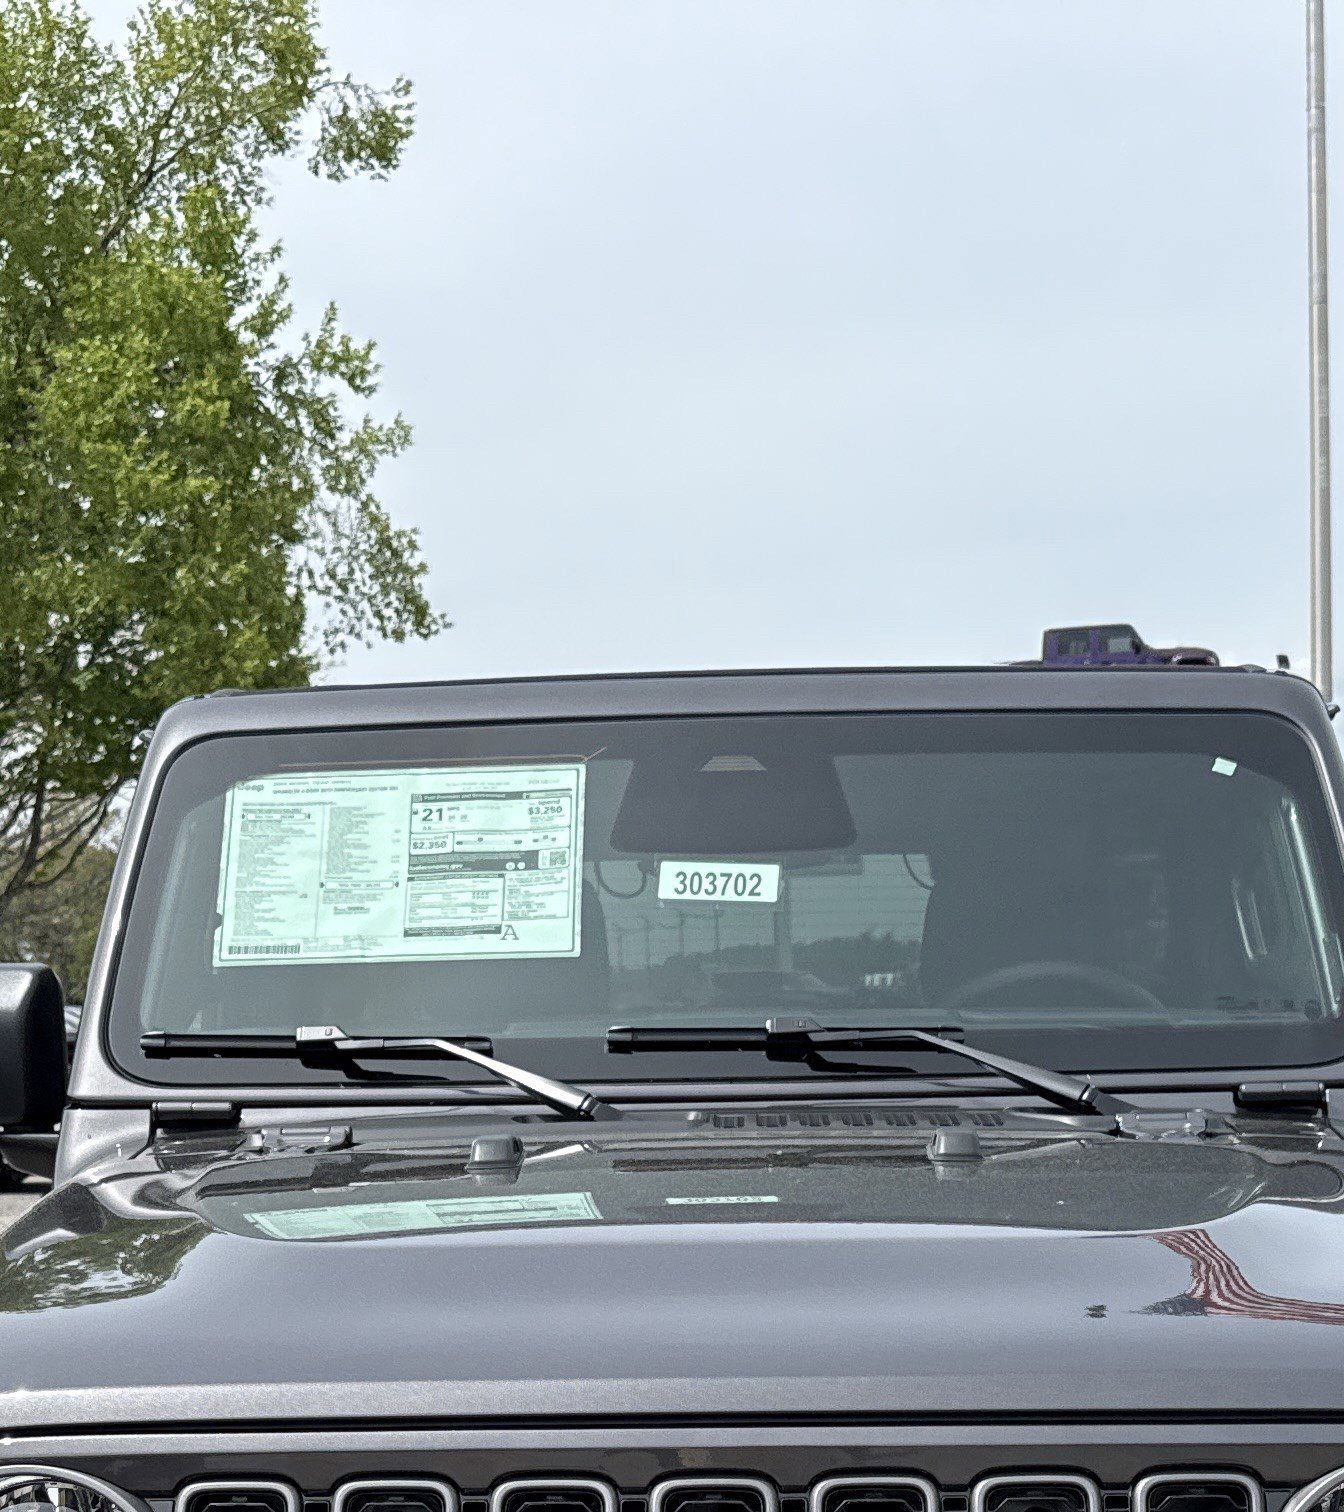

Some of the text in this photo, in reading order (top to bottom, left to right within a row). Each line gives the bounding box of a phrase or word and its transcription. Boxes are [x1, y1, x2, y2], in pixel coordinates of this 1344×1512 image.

[421, 808, 443, 822] 21
[674, 871, 763, 897] 303702
[500, 924, 520, 941] A
